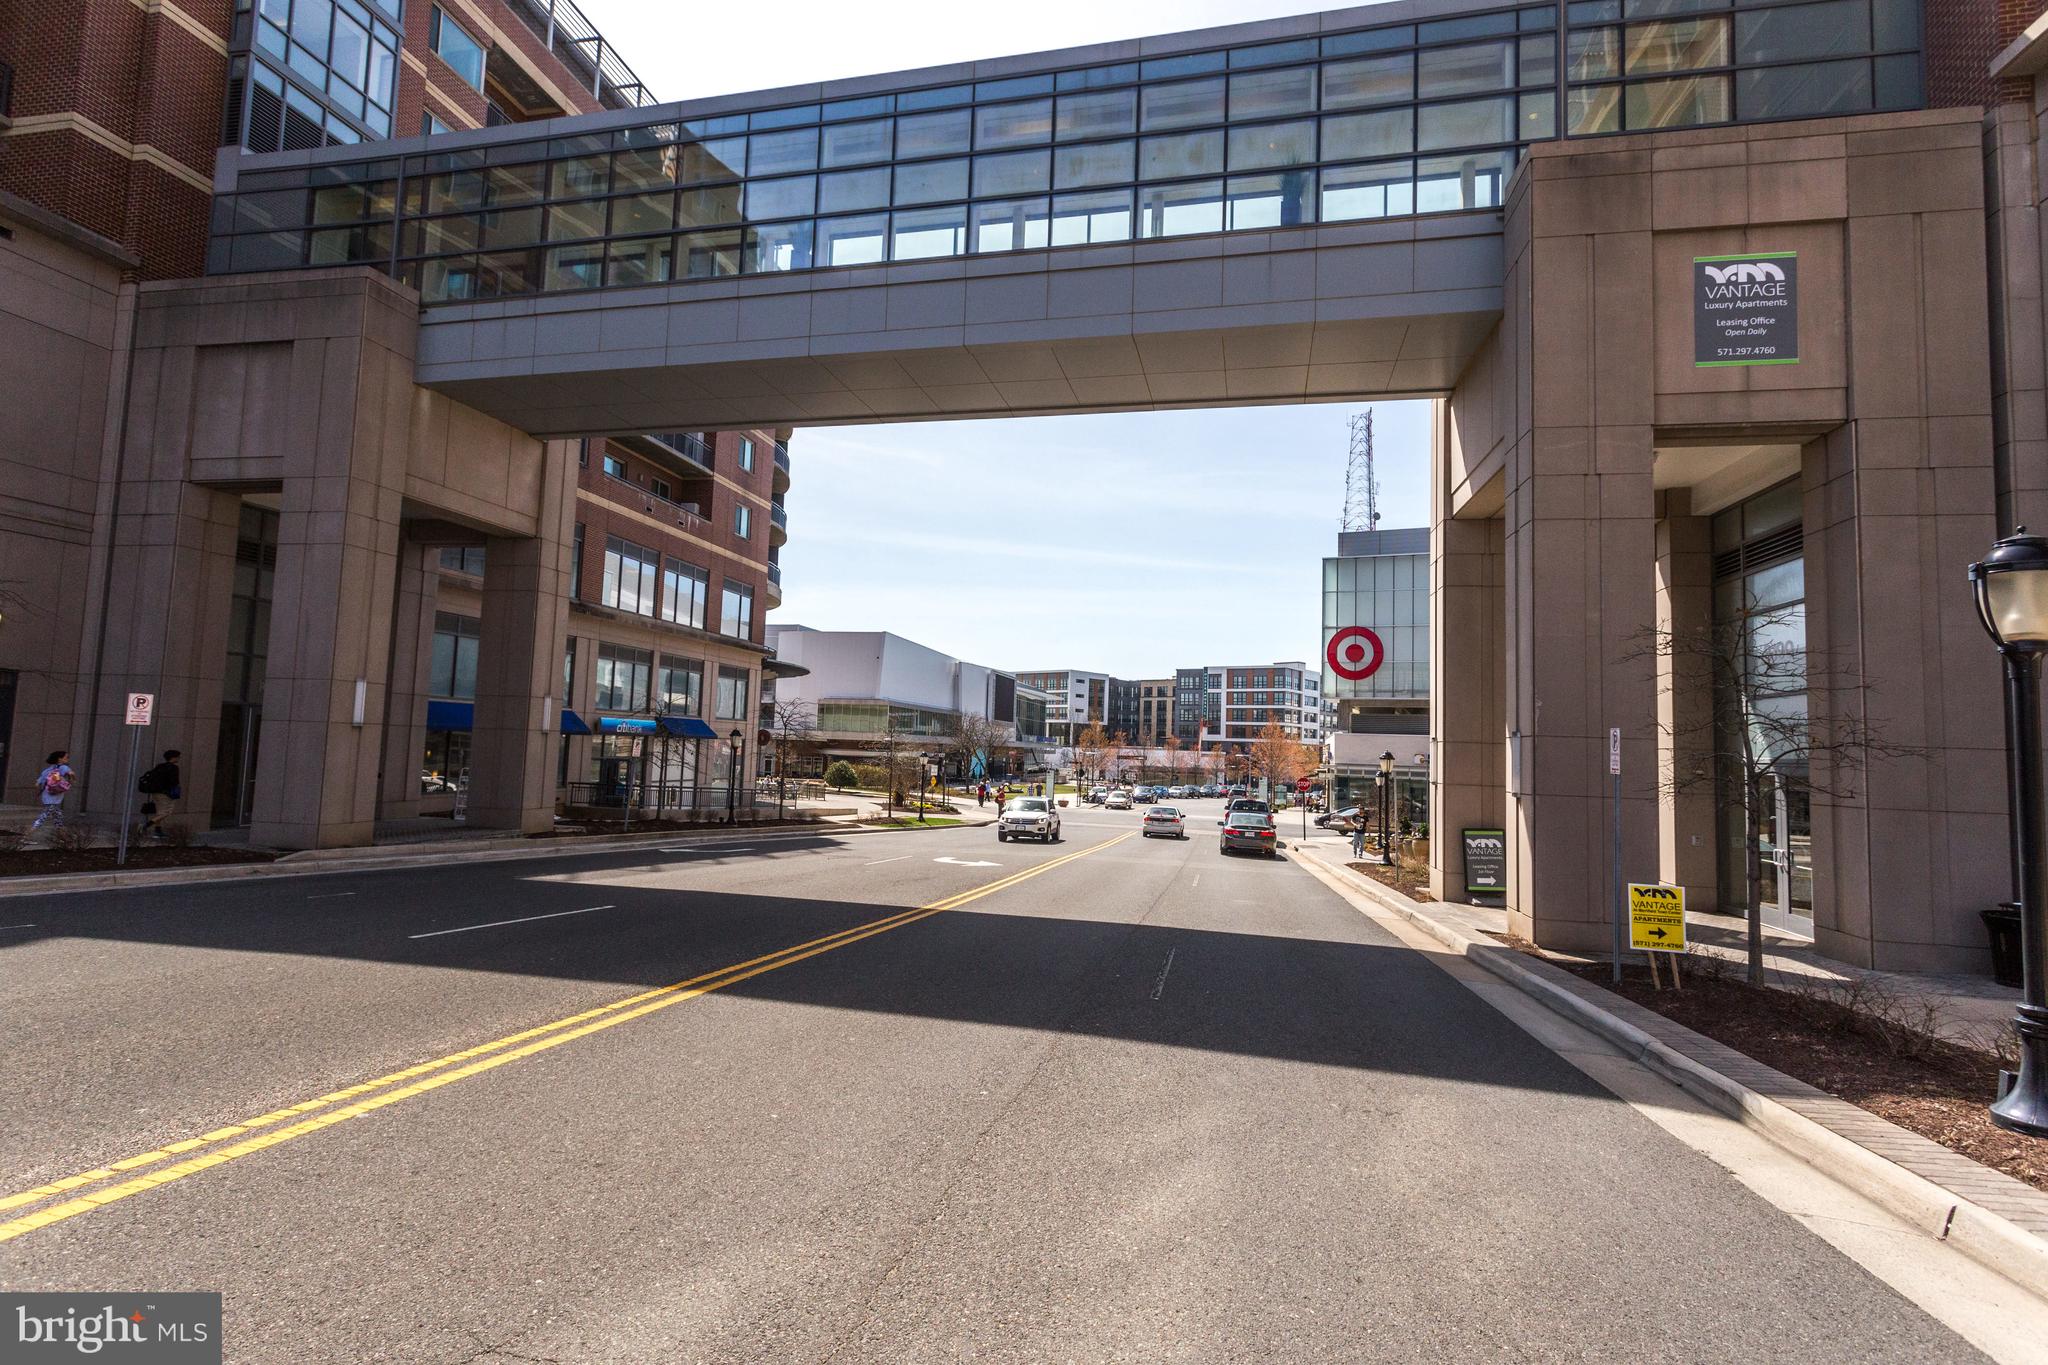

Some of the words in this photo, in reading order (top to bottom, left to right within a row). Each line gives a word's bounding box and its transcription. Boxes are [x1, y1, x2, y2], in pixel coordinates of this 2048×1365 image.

[1705, 282, 1786, 299] VANTAGE
[1704, 301, 1734, 310] Luxury
[1735, 299, 1788, 309] Apartments
[1716, 318, 1748, 327] Leasing
[1749, 317, 1776, 325] Office
[1725, 328, 1746, 337] Open
[1747, 327, 1767, 336] Daily
[1717, 346, 1776, 356] 571.297.4760
[1632, 900, 1681, 911] VANTAGE
[1633, 915, 1682, 924] APARTMENTS
